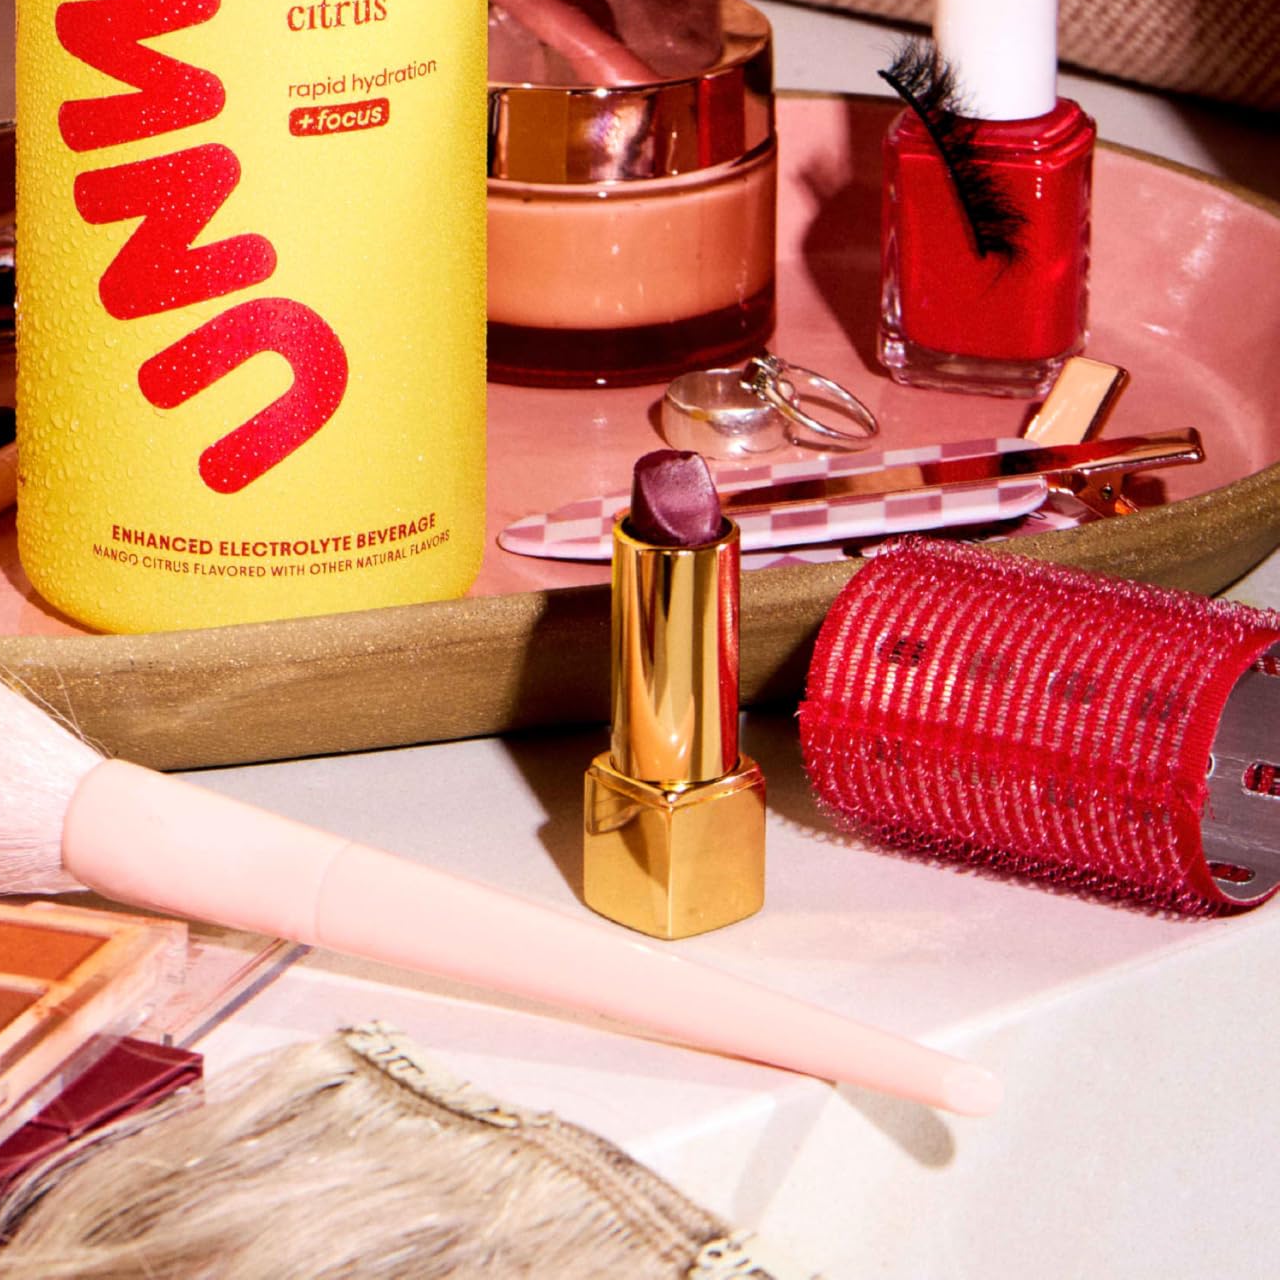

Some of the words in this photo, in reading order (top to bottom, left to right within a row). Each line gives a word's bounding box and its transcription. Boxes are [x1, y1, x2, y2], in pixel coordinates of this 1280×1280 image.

[288, 75, 346, 100] rapid
[352, 59, 438, 94] hydration
[298, 104, 384, 130] +focus
[93, 543, 138, 566] MANGO
[142, 555, 190, 574] CITRUS
[194, 562, 266, 577] FLAVORED
[271, 565, 305, 577] WITH
[309, 559, 352, 576] OTHER
[356, 550, 407, 569] NATURAL
[409, 529, 451, 557] FLAVORS
[112, 524, 213, 556] ENHANCED
[219, 535, 352, 557] ELECTROLYTE
[356, 512, 436, 549] BEVERAGE
